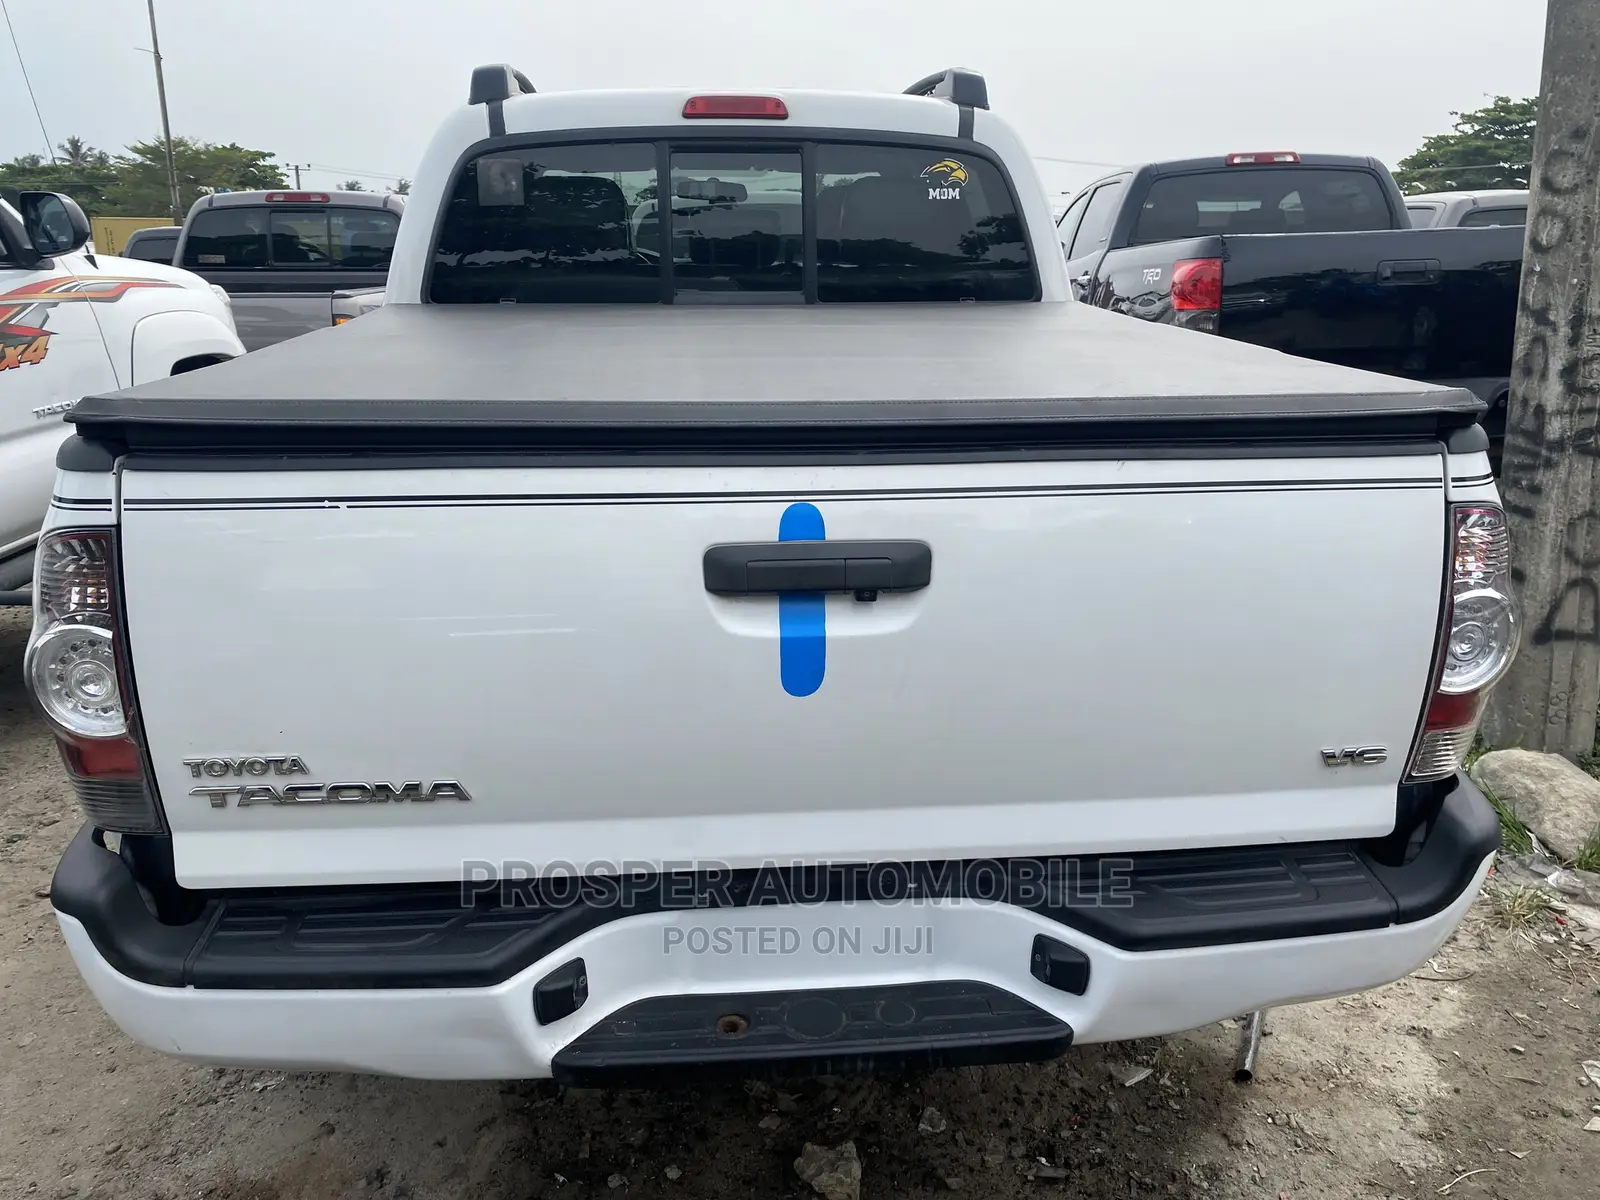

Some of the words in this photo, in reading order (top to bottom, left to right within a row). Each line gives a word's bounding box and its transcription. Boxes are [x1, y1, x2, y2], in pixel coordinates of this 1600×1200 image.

[928, 187, 960, 200] MOM
[183, 755, 310, 778] TOYOTA
[1320, 745, 1388, 767] V6
[188, 779, 472, 808] TACOMA
